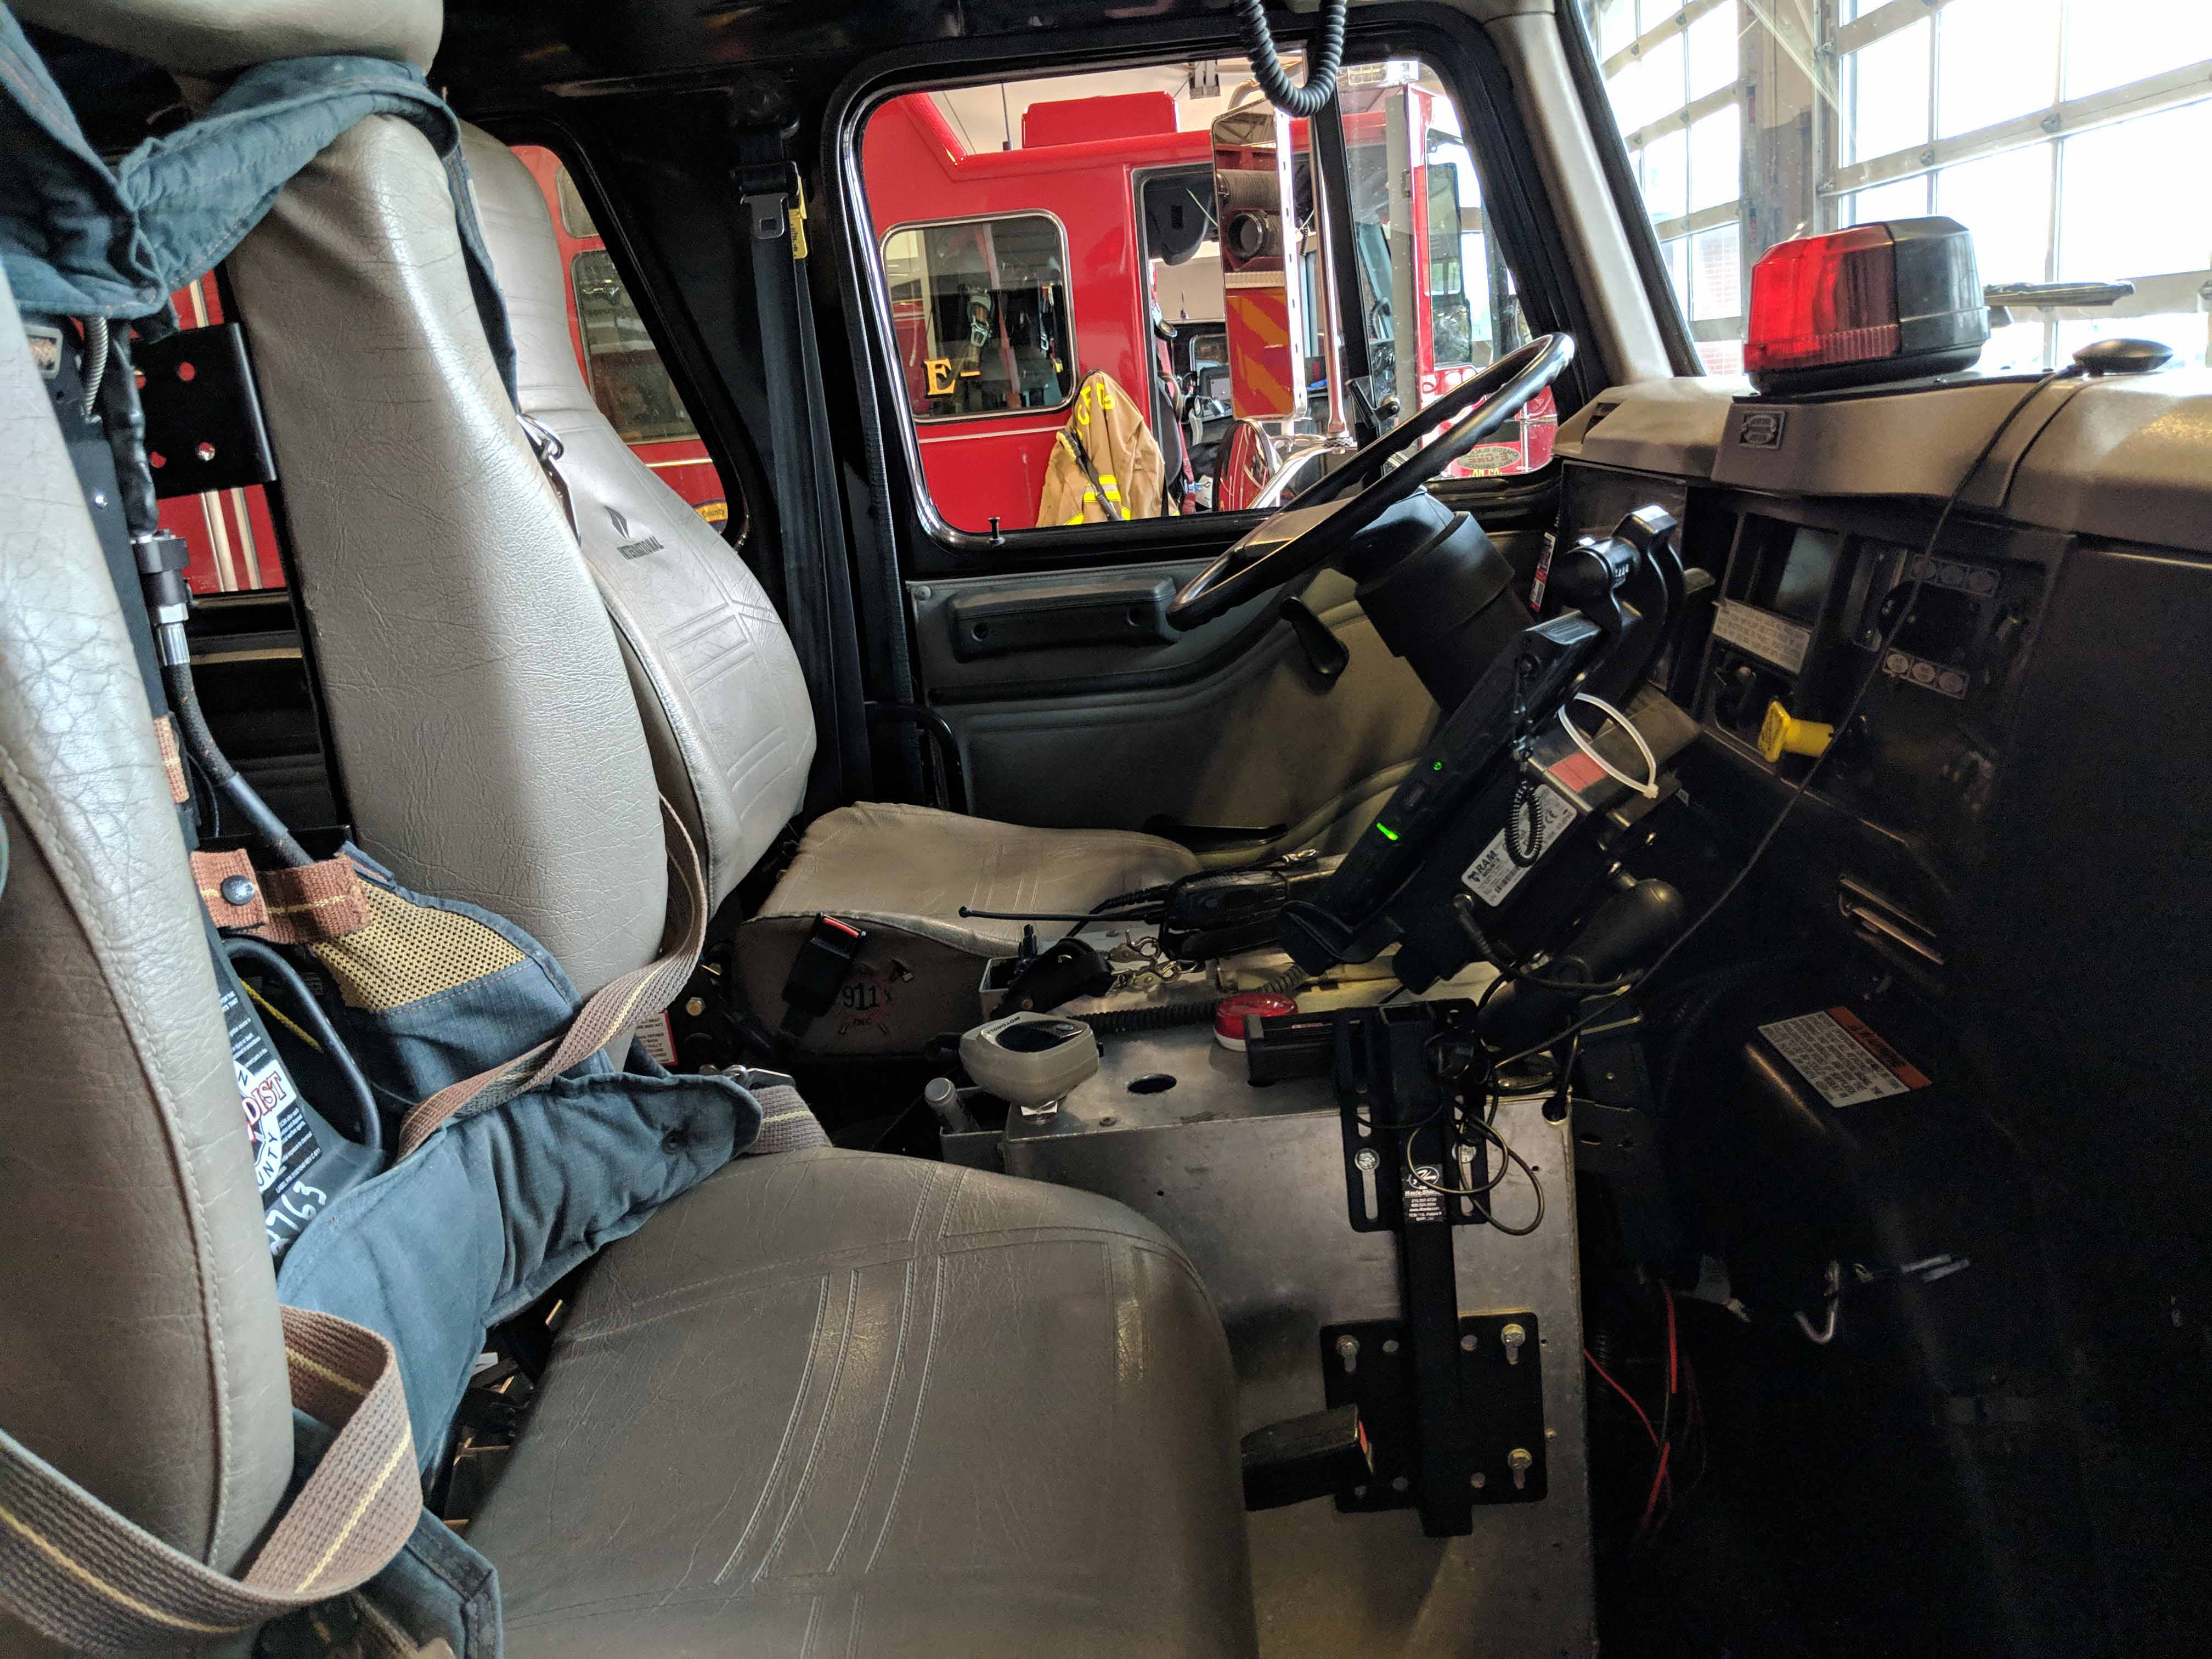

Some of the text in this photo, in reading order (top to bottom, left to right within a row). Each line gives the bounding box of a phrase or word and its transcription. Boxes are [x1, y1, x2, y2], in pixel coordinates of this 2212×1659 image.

[1476, 850, 1497, 874] RAM
[842, 983, 880, 1011] 911
[241, 1070, 286, 1125] DIST
[257, 1131, 278, 1186] UNTY
